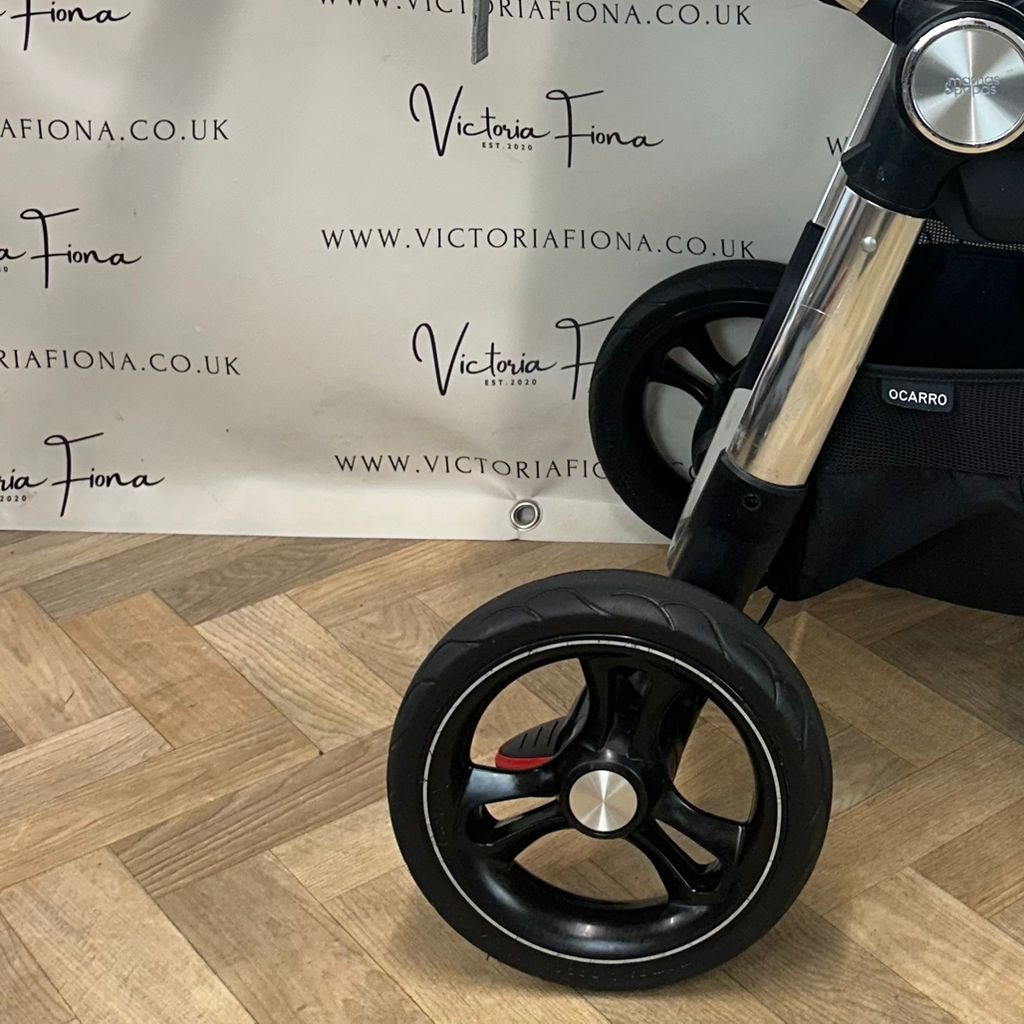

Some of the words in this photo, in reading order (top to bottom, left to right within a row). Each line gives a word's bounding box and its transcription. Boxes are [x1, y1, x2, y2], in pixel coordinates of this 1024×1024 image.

[409, 83, 551, 157] Victoria
[545, 89, 664, 168] Fiona
[482, 141, 533, 151] EST.2020
[20, 208, 142, 288] Fiona
[321, 228, 755, 259] WWW.VICTORIAFIONA.CO.UK
[412, 320, 558, 396] Victoria
[485, 378, 538, 387] EST.2020
[888, 388, 948, 406] OCARRO
[44, 432, 165, 517] Fiona
